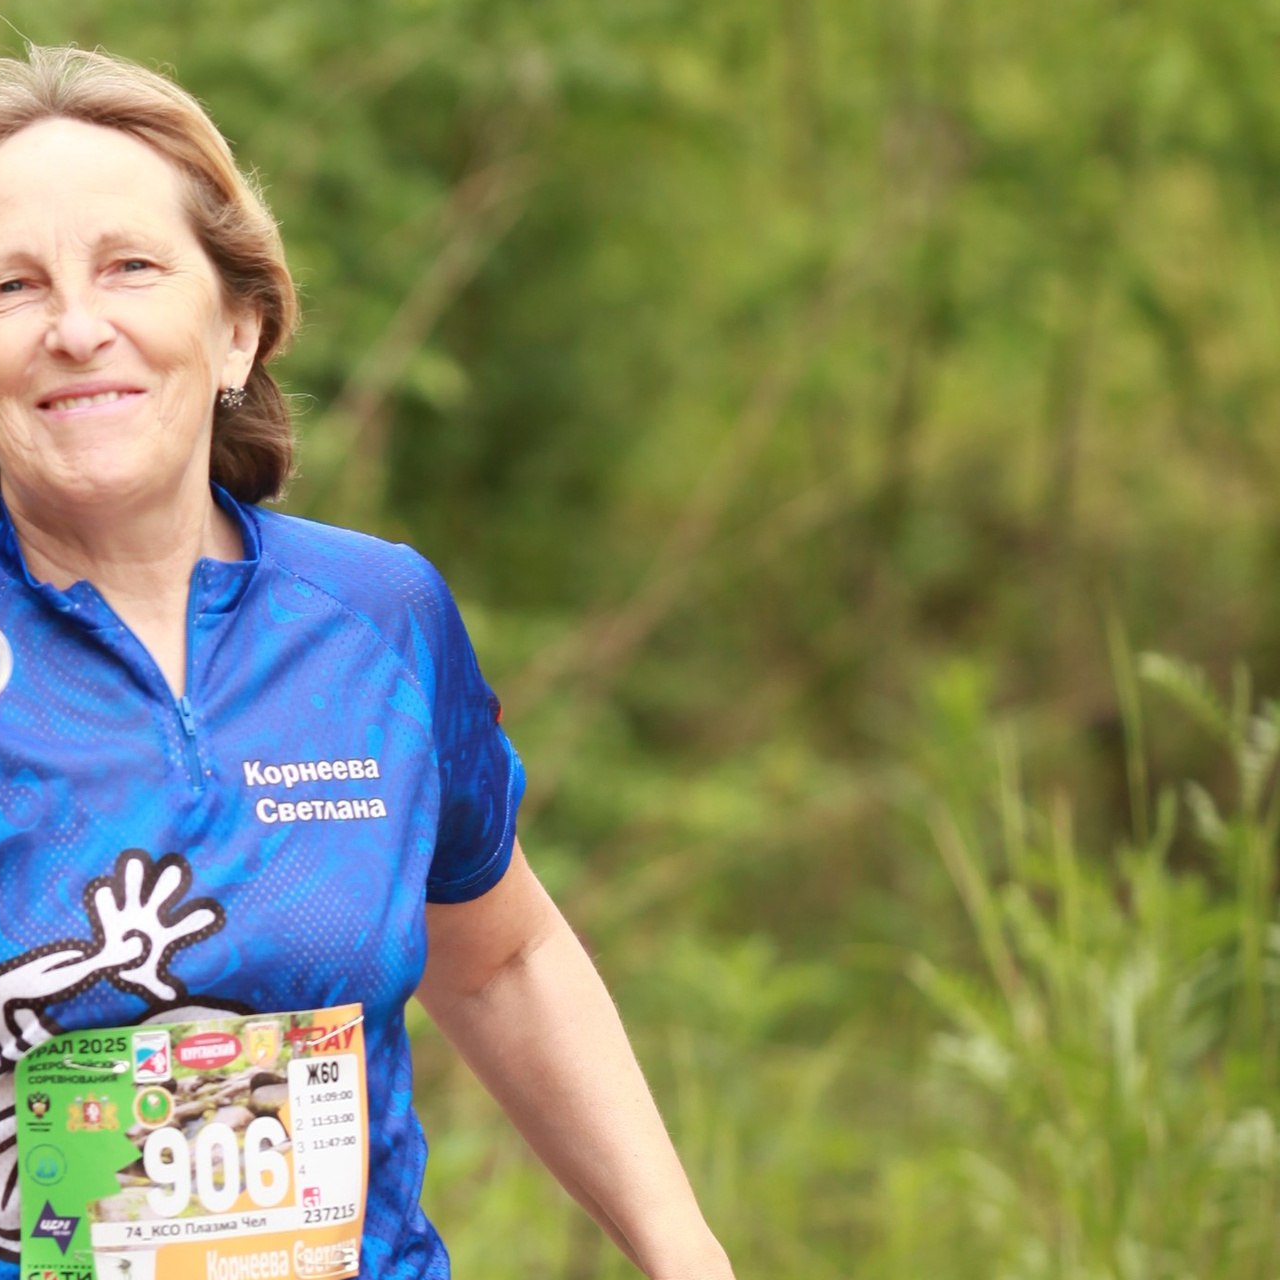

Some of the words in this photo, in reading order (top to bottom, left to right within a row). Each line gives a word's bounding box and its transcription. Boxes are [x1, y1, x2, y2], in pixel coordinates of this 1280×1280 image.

[242, 758, 380, 788] Корнеева
[255, 797, 388, 824] Светлана
[79, 1037, 127, 1054] 2025
[28, 1074, 118, 1085] СОРЕВНОВАНИЯ
[306, 1061, 339, 1086] Ж60
[296, 1096, 302, 1107] 1
[310, 1090, 353, 1104] 14:09:00
[296, 1119, 304, 1131] 2
[312, 1113, 355, 1127] 11:53:00
[297, 1142, 305, 1154] 3
[313, 1136, 356, 1150] 11:47:00
[143, 1116, 289, 1217] 906
[298, 1165, 306, 1176] 4
[304, 1203, 355, 1224] 237215
[125, 1224, 180, 1240] 74_КСО
[185, 1220, 237, 1235] Плазма
[242, 1217, 267, 1228] Чел
